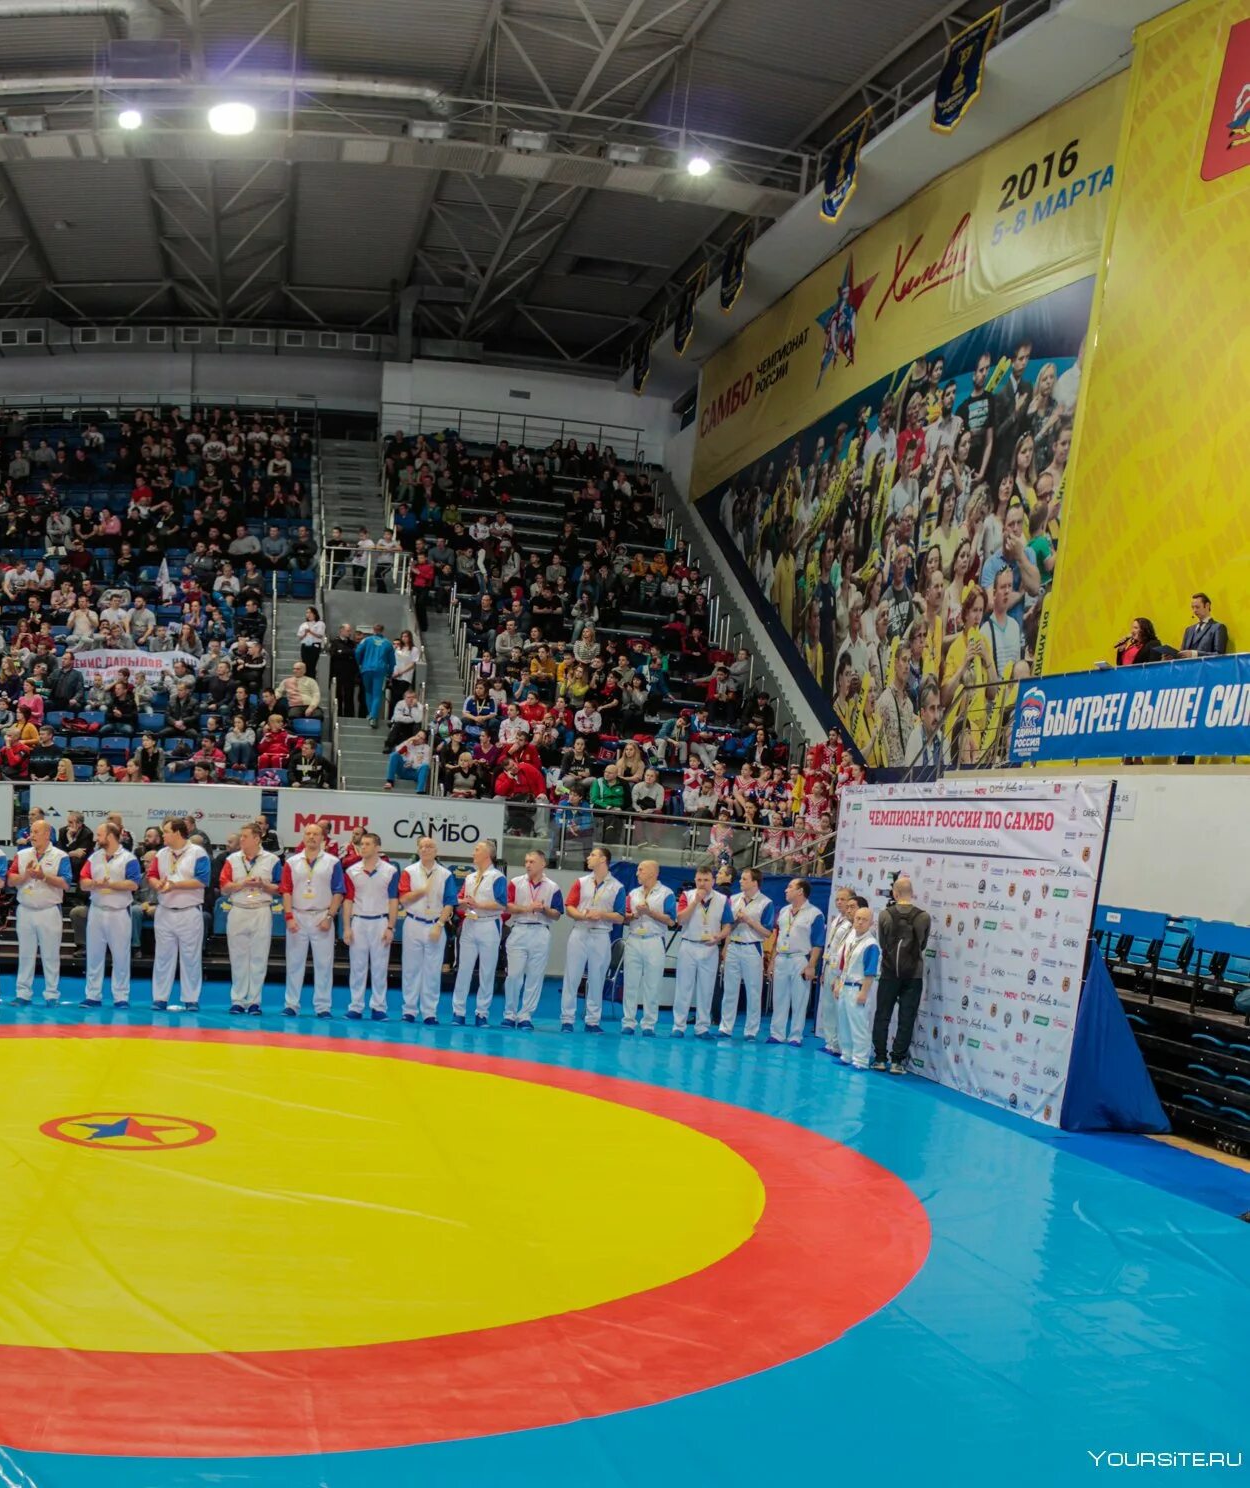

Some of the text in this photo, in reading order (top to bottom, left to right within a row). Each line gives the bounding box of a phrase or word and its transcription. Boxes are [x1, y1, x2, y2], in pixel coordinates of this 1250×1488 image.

[998, 139, 1080, 213] 2016
[991, 164, 1114, 247] 5-8 МАРТА
[757, 327, 809, 376] ЧЕМПИОНАТ
[755, 361, 789, 398] РОССИИ
[701, 371, 753, 439] САМБО
[1015, 726, 1042, 738] ЕДИНАЯ
[1042, 692, 1128, 737] БЫСТРЕЕ!
[1126, 686, 1204, 731] ВЫШЕ!
[1013, 737, 1040, 748] РОССИЯ
[393, 817, 480, 844] САМБО
[869, 810, 1055, 832] ЧЕМПИОНАТ РОССИИ ПО САМБО
